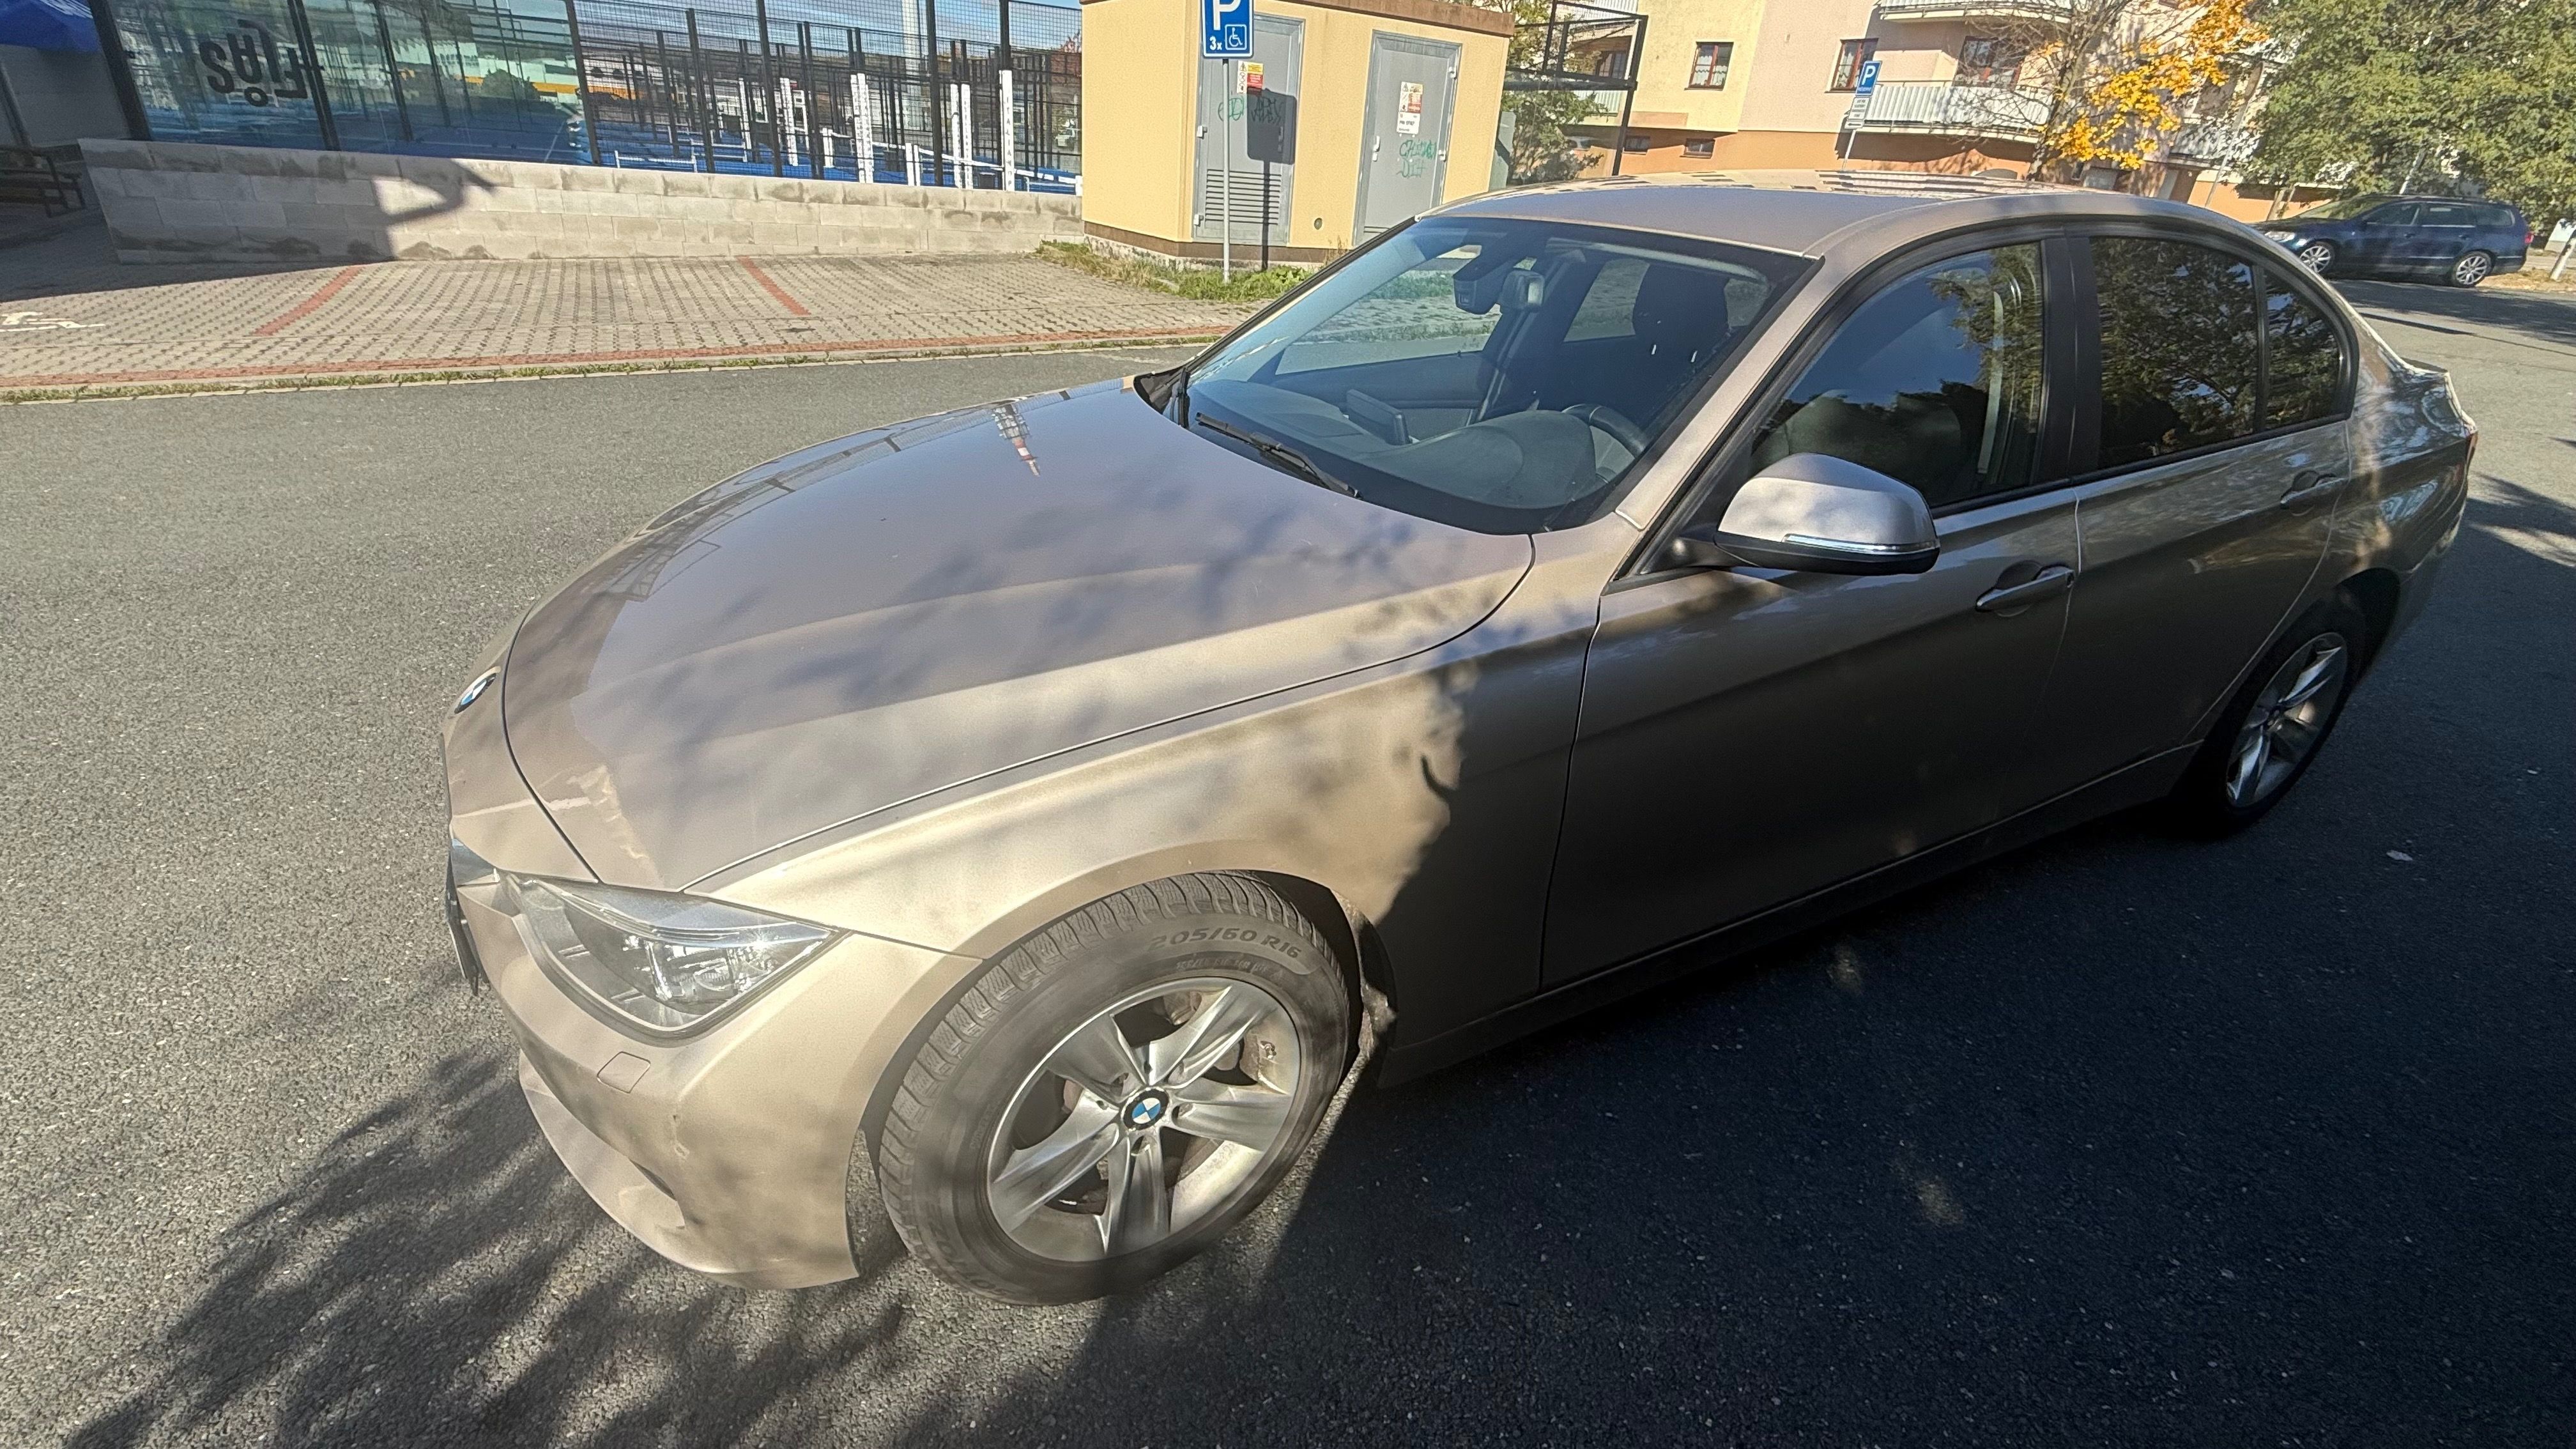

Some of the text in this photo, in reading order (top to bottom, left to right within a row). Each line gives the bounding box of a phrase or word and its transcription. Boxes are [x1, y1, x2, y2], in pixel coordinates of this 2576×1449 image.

[1209, 36, 1222, 50] 3x
[1862, 65, 1876, 85] P
[1147, 927, 1302, 958] 205/60 R16
